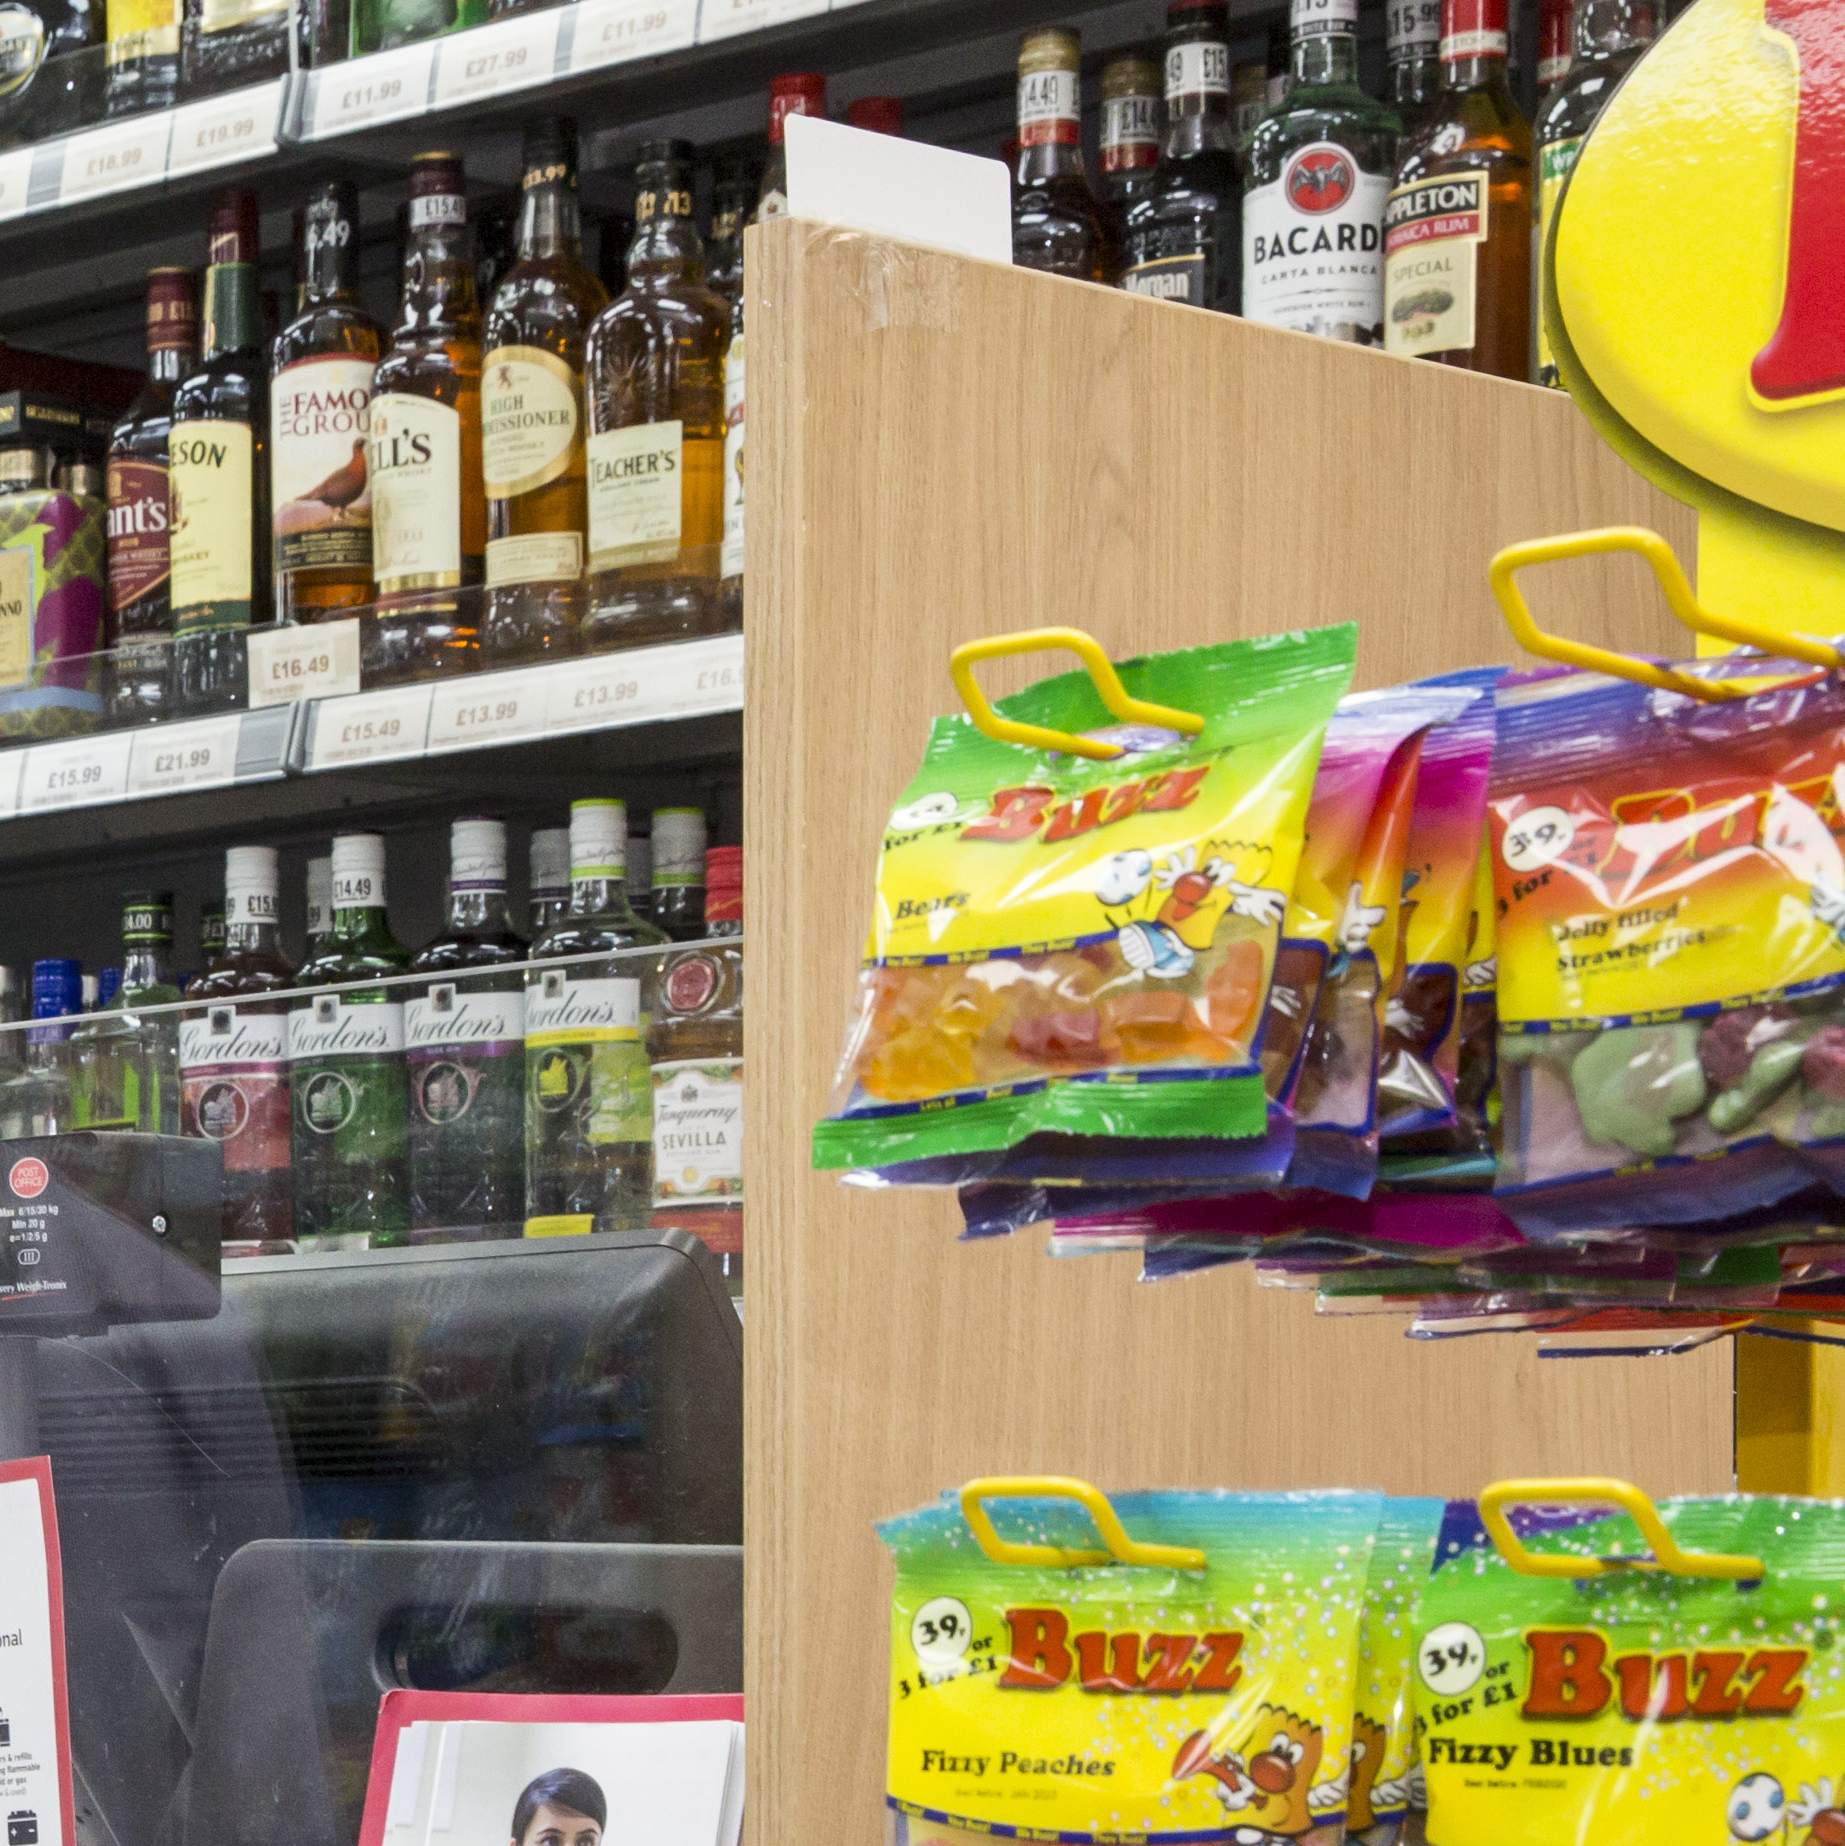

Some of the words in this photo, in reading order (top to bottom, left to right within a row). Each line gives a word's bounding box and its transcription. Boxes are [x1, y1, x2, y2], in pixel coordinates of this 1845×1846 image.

[465, 49, 526, 78] £27.99
[342, 81, 401, 109] £11.99
[1262, 267, 1309, 285] CARTA
[1317, 264, 1377, 276] BLANCA
[1394, 259, 1453, 282] SPECIAL
[292, 386, 370, 414] FAMO
[292, 412, 372, 436] GROU
[590, 449, 676, 483] TEACHER'S
[273, 656, 329, 680] £16.49
[456, 703, 517, 727] £13.99
[342, 720, 401, 742] £15.49
[155, 749, 210, 773] £21.99
[48, 765, 100, 790] £15.99
[959, 765, 1210, 844] Buzz
[181, 1023, 283, 1063] Gordon's
[291, 1012, 390, 1053] Gordon's
[657, 1104, 736, 1125] Tanqueray
[663, 1132, 725, 1148] SEVILLA
[997, 1607, 1247, 1696] Buzz
[917, 1660, 963, 1693] for
[966, 1652, 998, 1679] £1
[1521, 1626, 1811, 1722] Buzz
[921, 1746, 992, 1780] Fizzy
[999, 1752, 1115, 1778] Peaches
[1427, 1736, 1520, 1774] Fizzy
[1529, 1738, 1633, 1769] Blues
